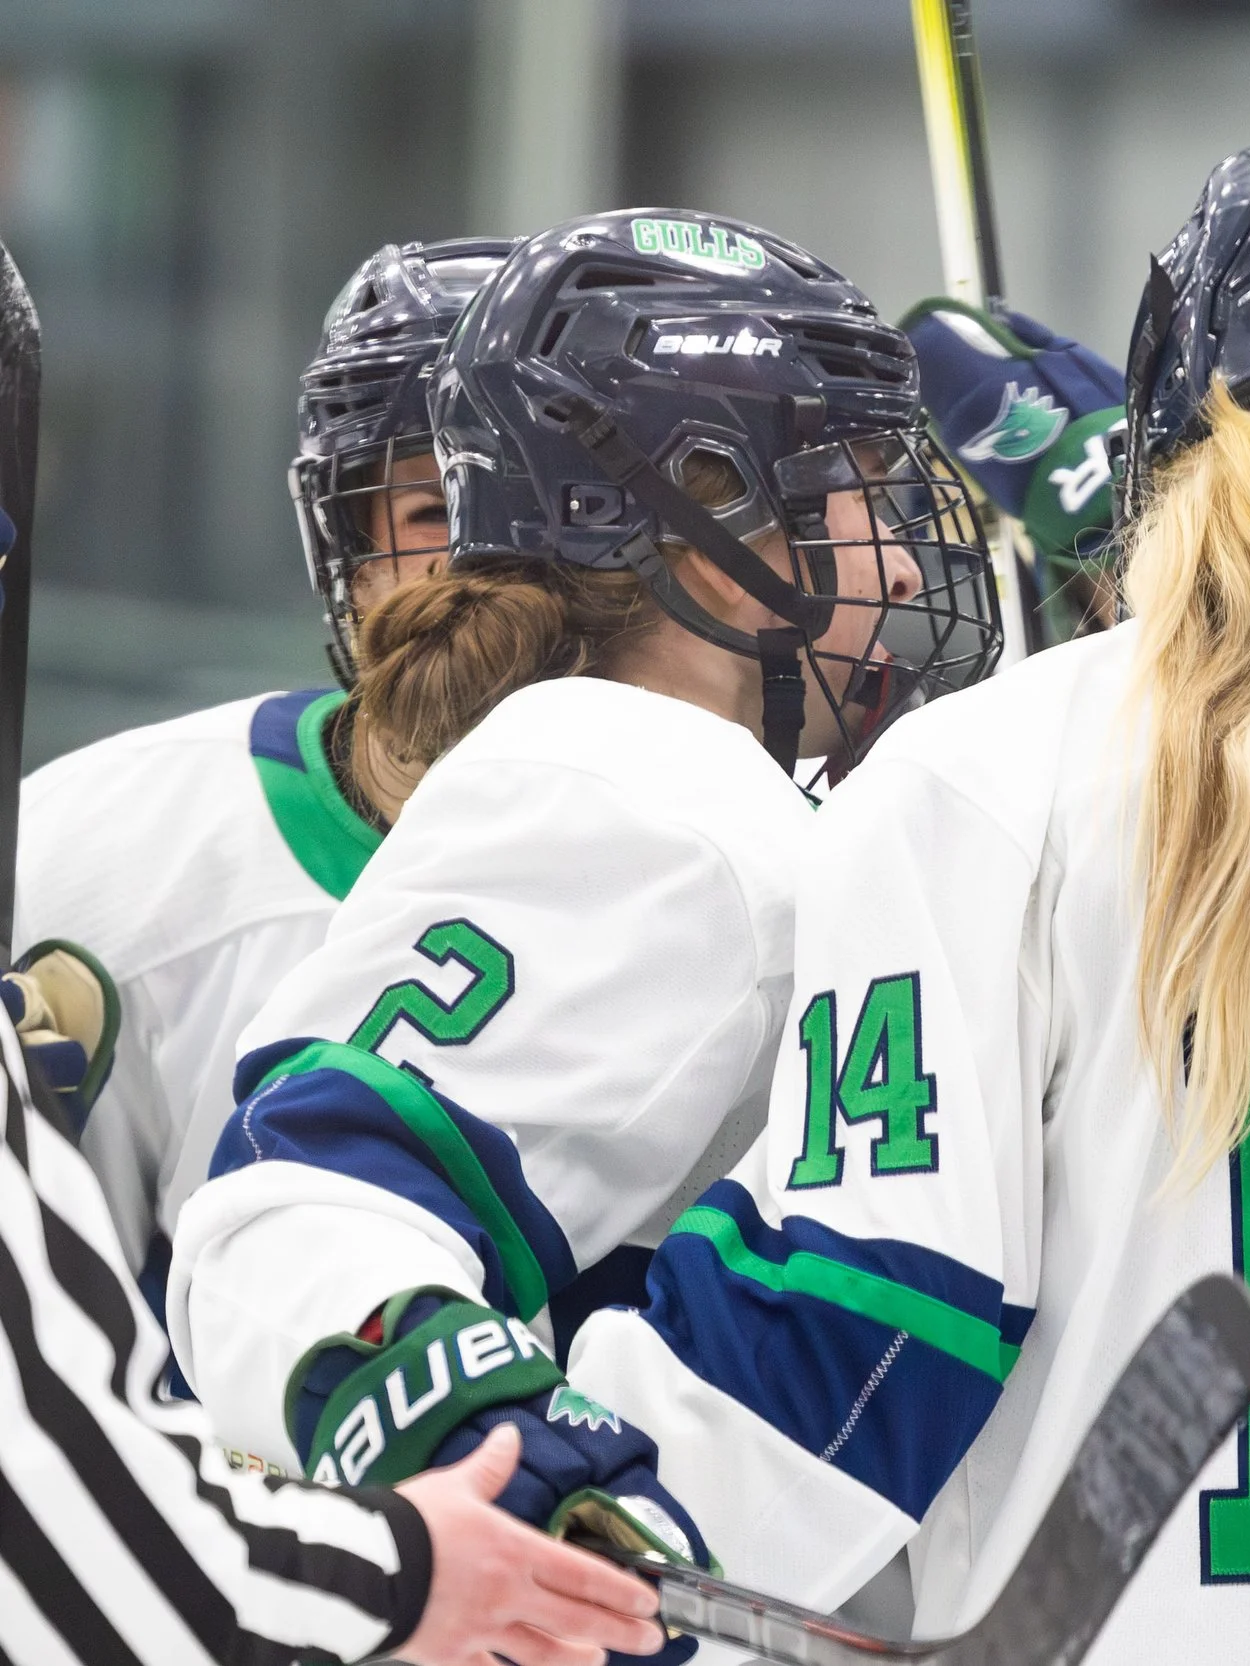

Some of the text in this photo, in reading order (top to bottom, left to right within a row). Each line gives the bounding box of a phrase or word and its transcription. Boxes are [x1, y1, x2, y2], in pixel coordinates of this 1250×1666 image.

[631, 218, 766, 270] GULLS
[653, 334, 783, 358] BAUER
[347, 917, 515, 1087] 2
[785, 970, 939, 1191] 14
